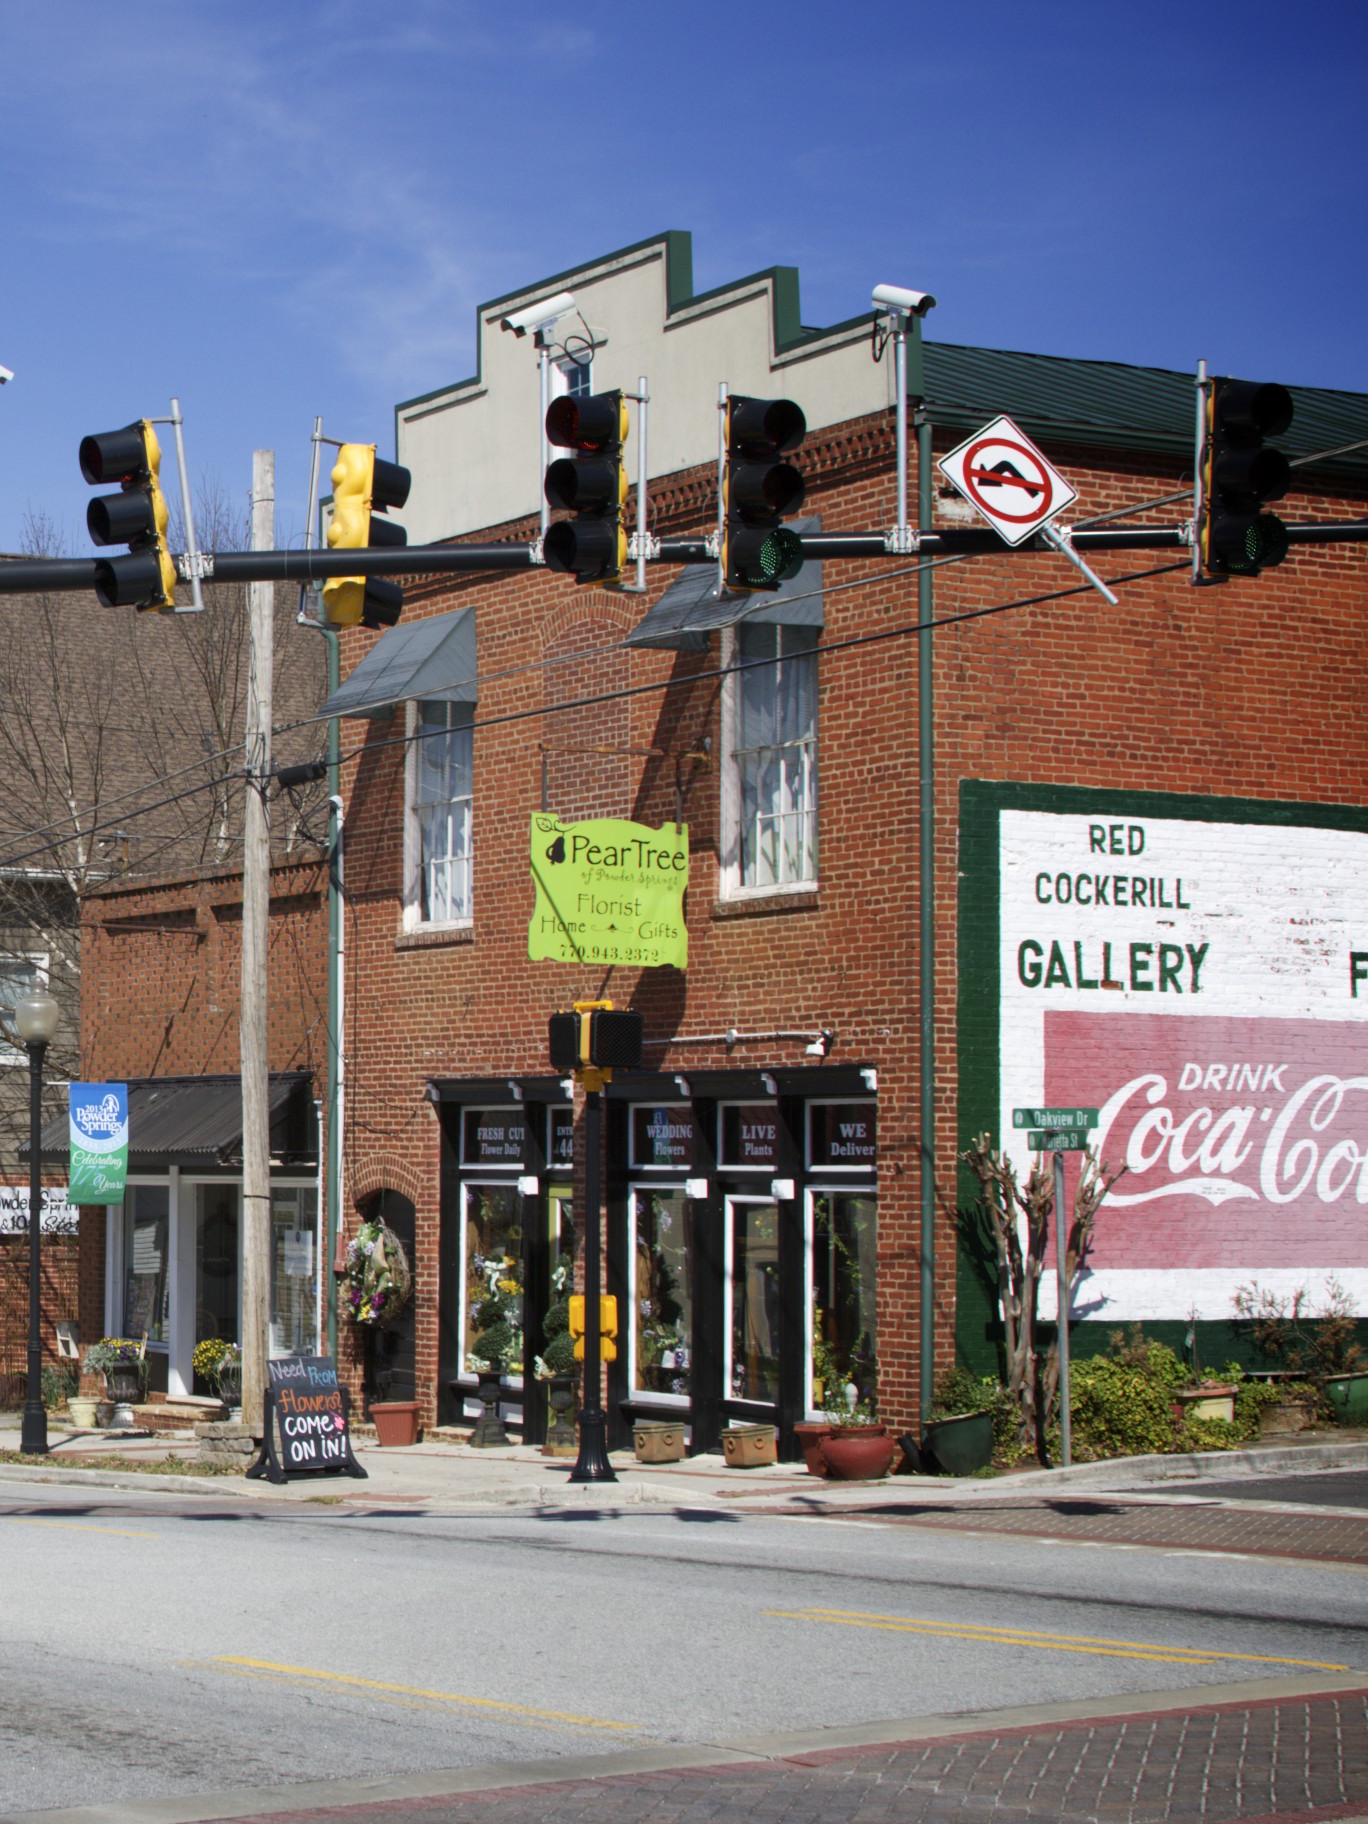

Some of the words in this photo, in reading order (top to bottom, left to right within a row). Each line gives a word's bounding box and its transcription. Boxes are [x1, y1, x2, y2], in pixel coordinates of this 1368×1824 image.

[1089, 824, 1145, 856] RED
[596, 868, 634, 883] Powder
[637, 870, 678, 891] Springs
[1035, 872, 1191, 910] COCKERILL
[577, 893, 642, 917] Florist
[541, 916, 586, 934] Home
[638, 921, 678, 939] Gifts
[560, 944, 660, 962] 770.943.2372
[1017, 939, 1210, 994] GALLERY
[1177, 1063, 1289, 1092] DRINK
[76, 1107, 118, 1121] Powder
[85, 1105, 103, 1113] 2013
[1034, 1110, 1074, 1126] Oakview
[1076, 1110, 1088, 1126] Dr
[81, 1120, 123, 1135] Springs
[477, 1127, 504, 1140] FRESH
[646, 1124, 693, 1139] WEDDING
[742, 1125, 776, 1140] LIVE
[839, 1123, 867, 1139] WE
[655, 1142, 685, 1156] Flowers
[830, 1142, 875, 1156] Deliver
[1070, 1132, 1079, 1148] St
[481, 1143, 503, 1155] Flower
[504, 1143, 521, 1157] Daily
[744, 1142, 773, 1157] Plants
[72, 1150, 123, 1170] Celebrating
[72, 1165, 106, 1187] 175
[93, 1174, 124, 1195] Years
[269, 1358, 306, 1382] Need
[279, 1389, 343, 1413] flowers?
[291, 1439, 316, 1462] ON
